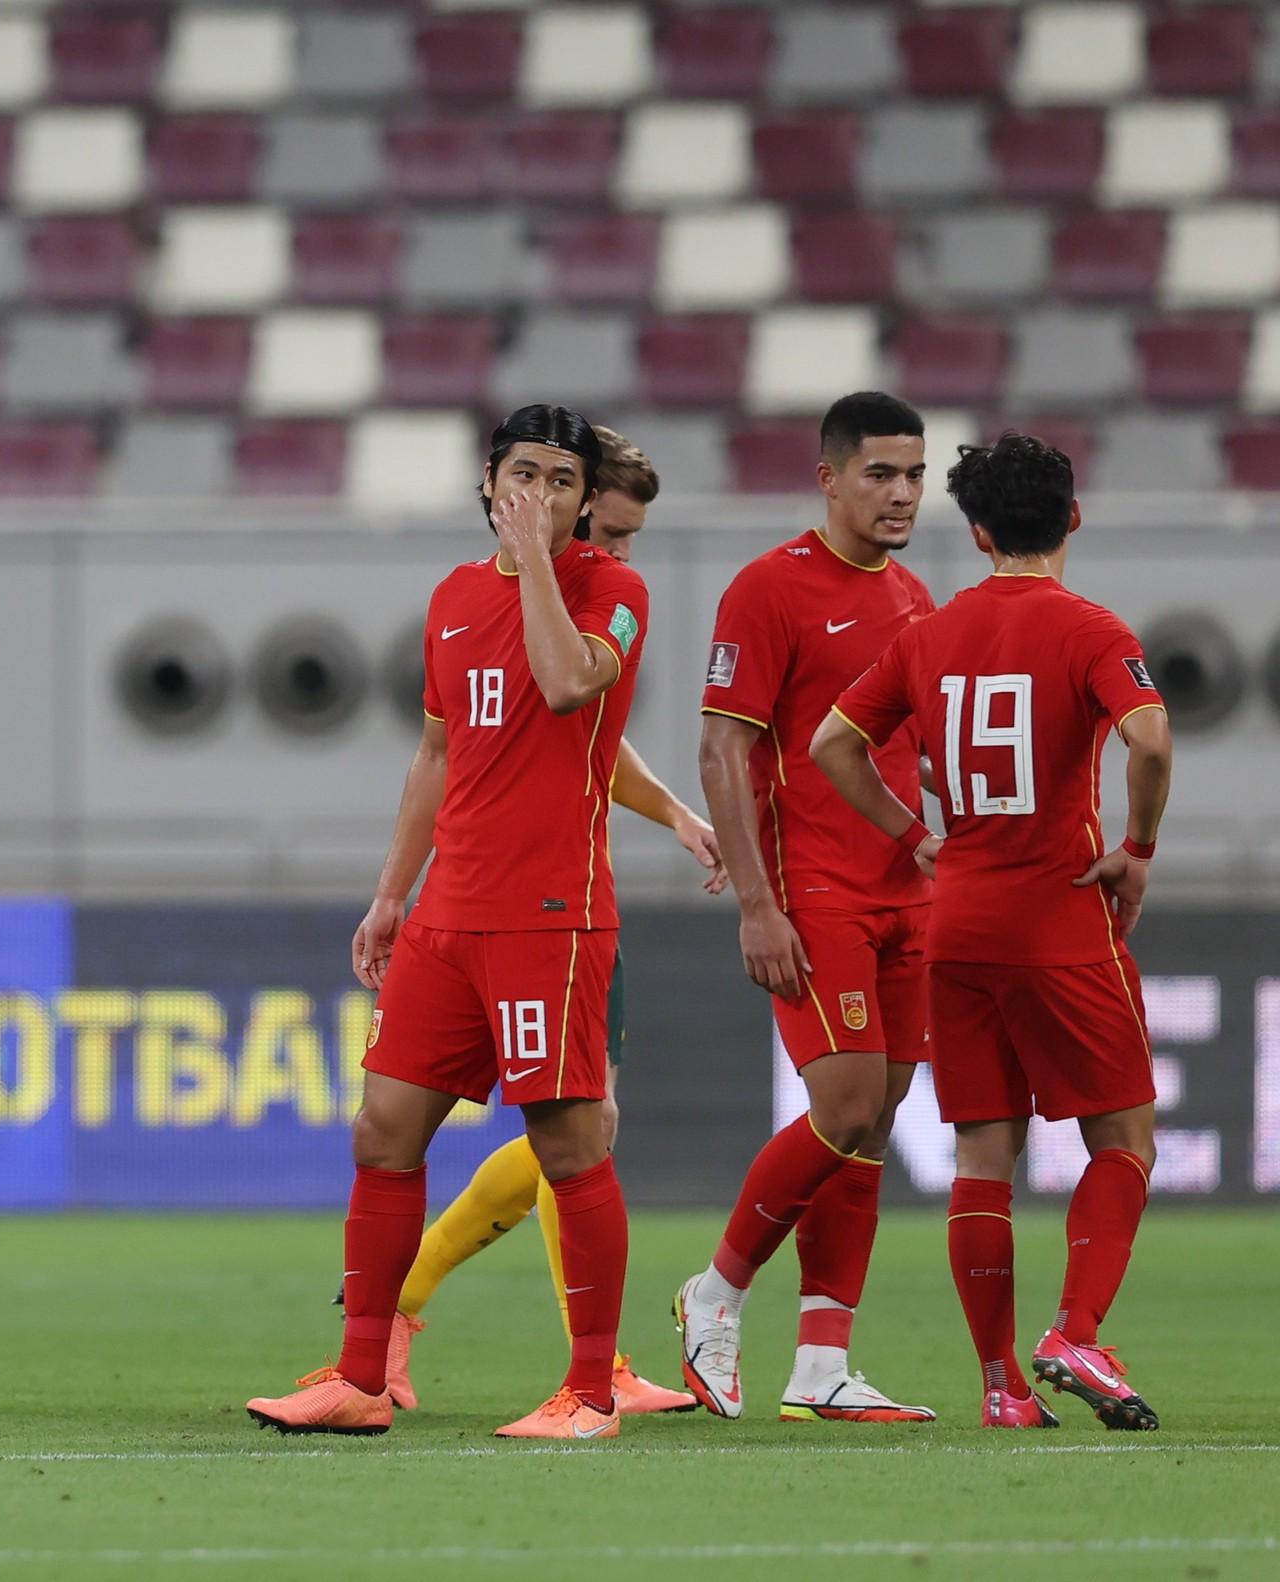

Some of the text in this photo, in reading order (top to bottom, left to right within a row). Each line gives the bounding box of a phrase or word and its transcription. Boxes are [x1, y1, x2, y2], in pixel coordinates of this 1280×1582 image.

[466, 667, 505, 728] 18
[940, 674, 1036, 816] 19
[497, 1000, 548, 1060] 18
